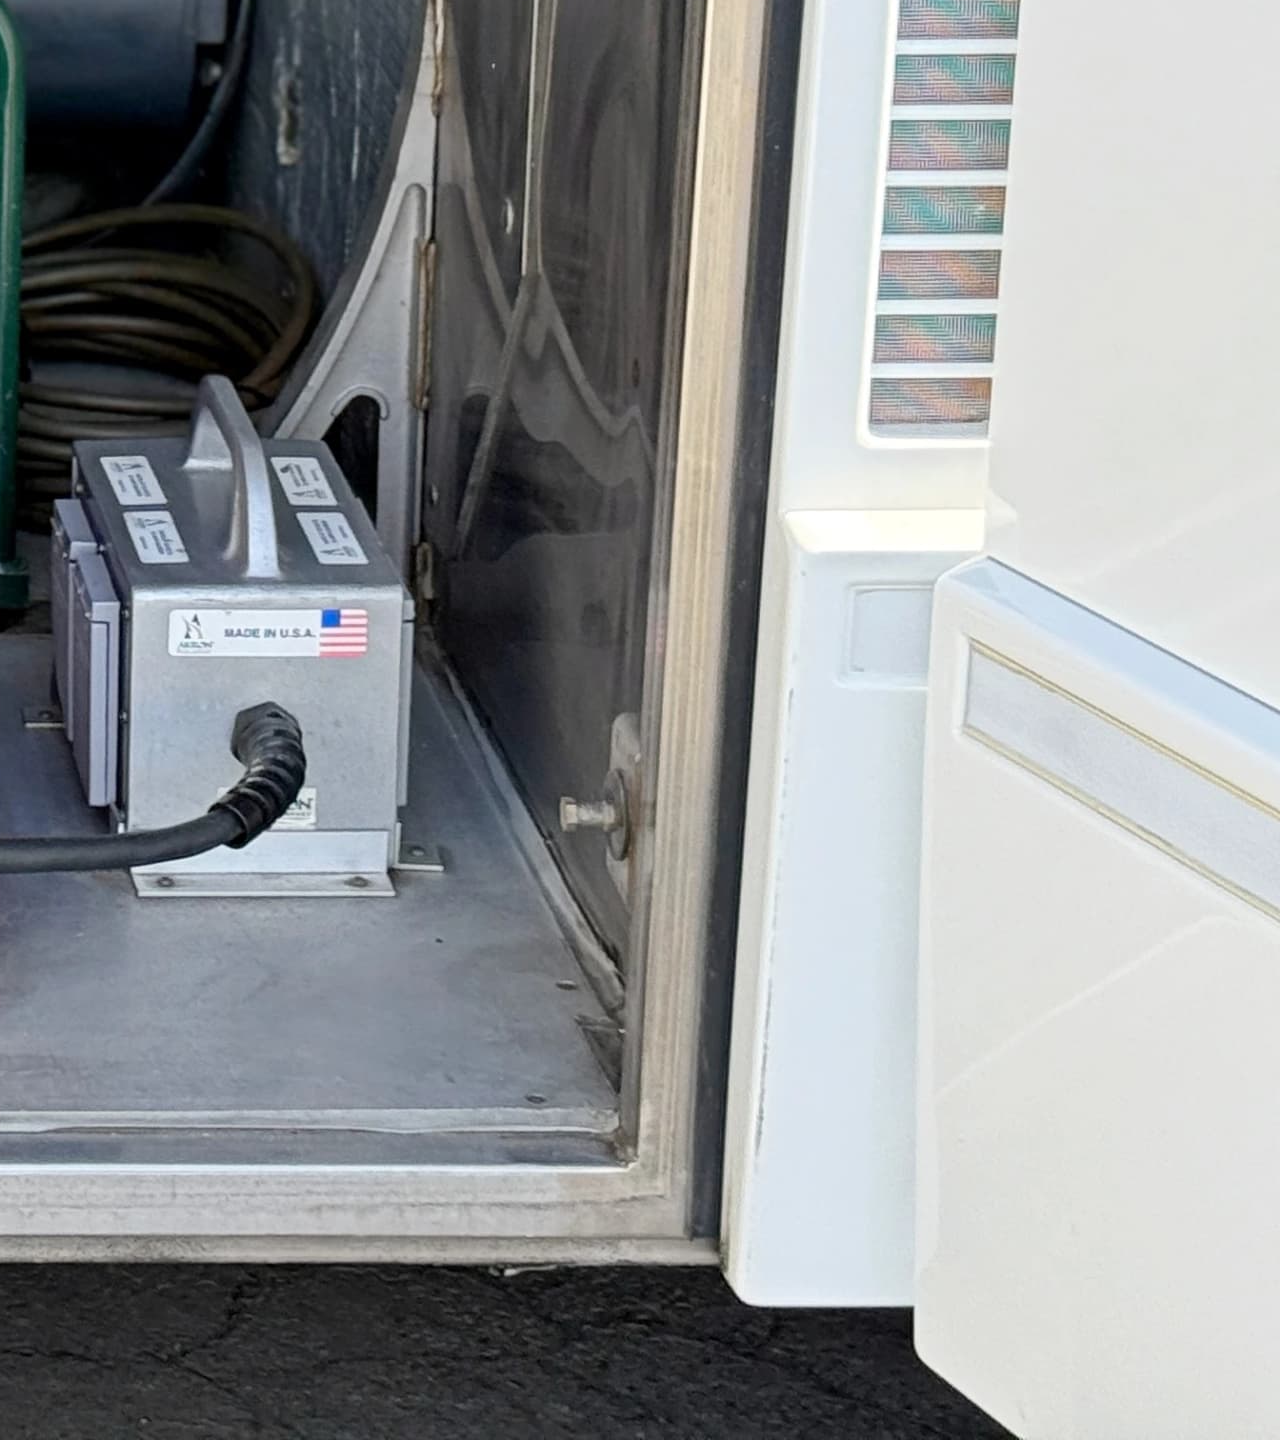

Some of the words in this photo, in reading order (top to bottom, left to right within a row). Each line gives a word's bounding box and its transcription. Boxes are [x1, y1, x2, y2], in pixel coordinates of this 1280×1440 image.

[224, 628, 261, 639] MADE
[264, 628, 277, 639] IN
[279, 628, 317, 639] U.S.A.
